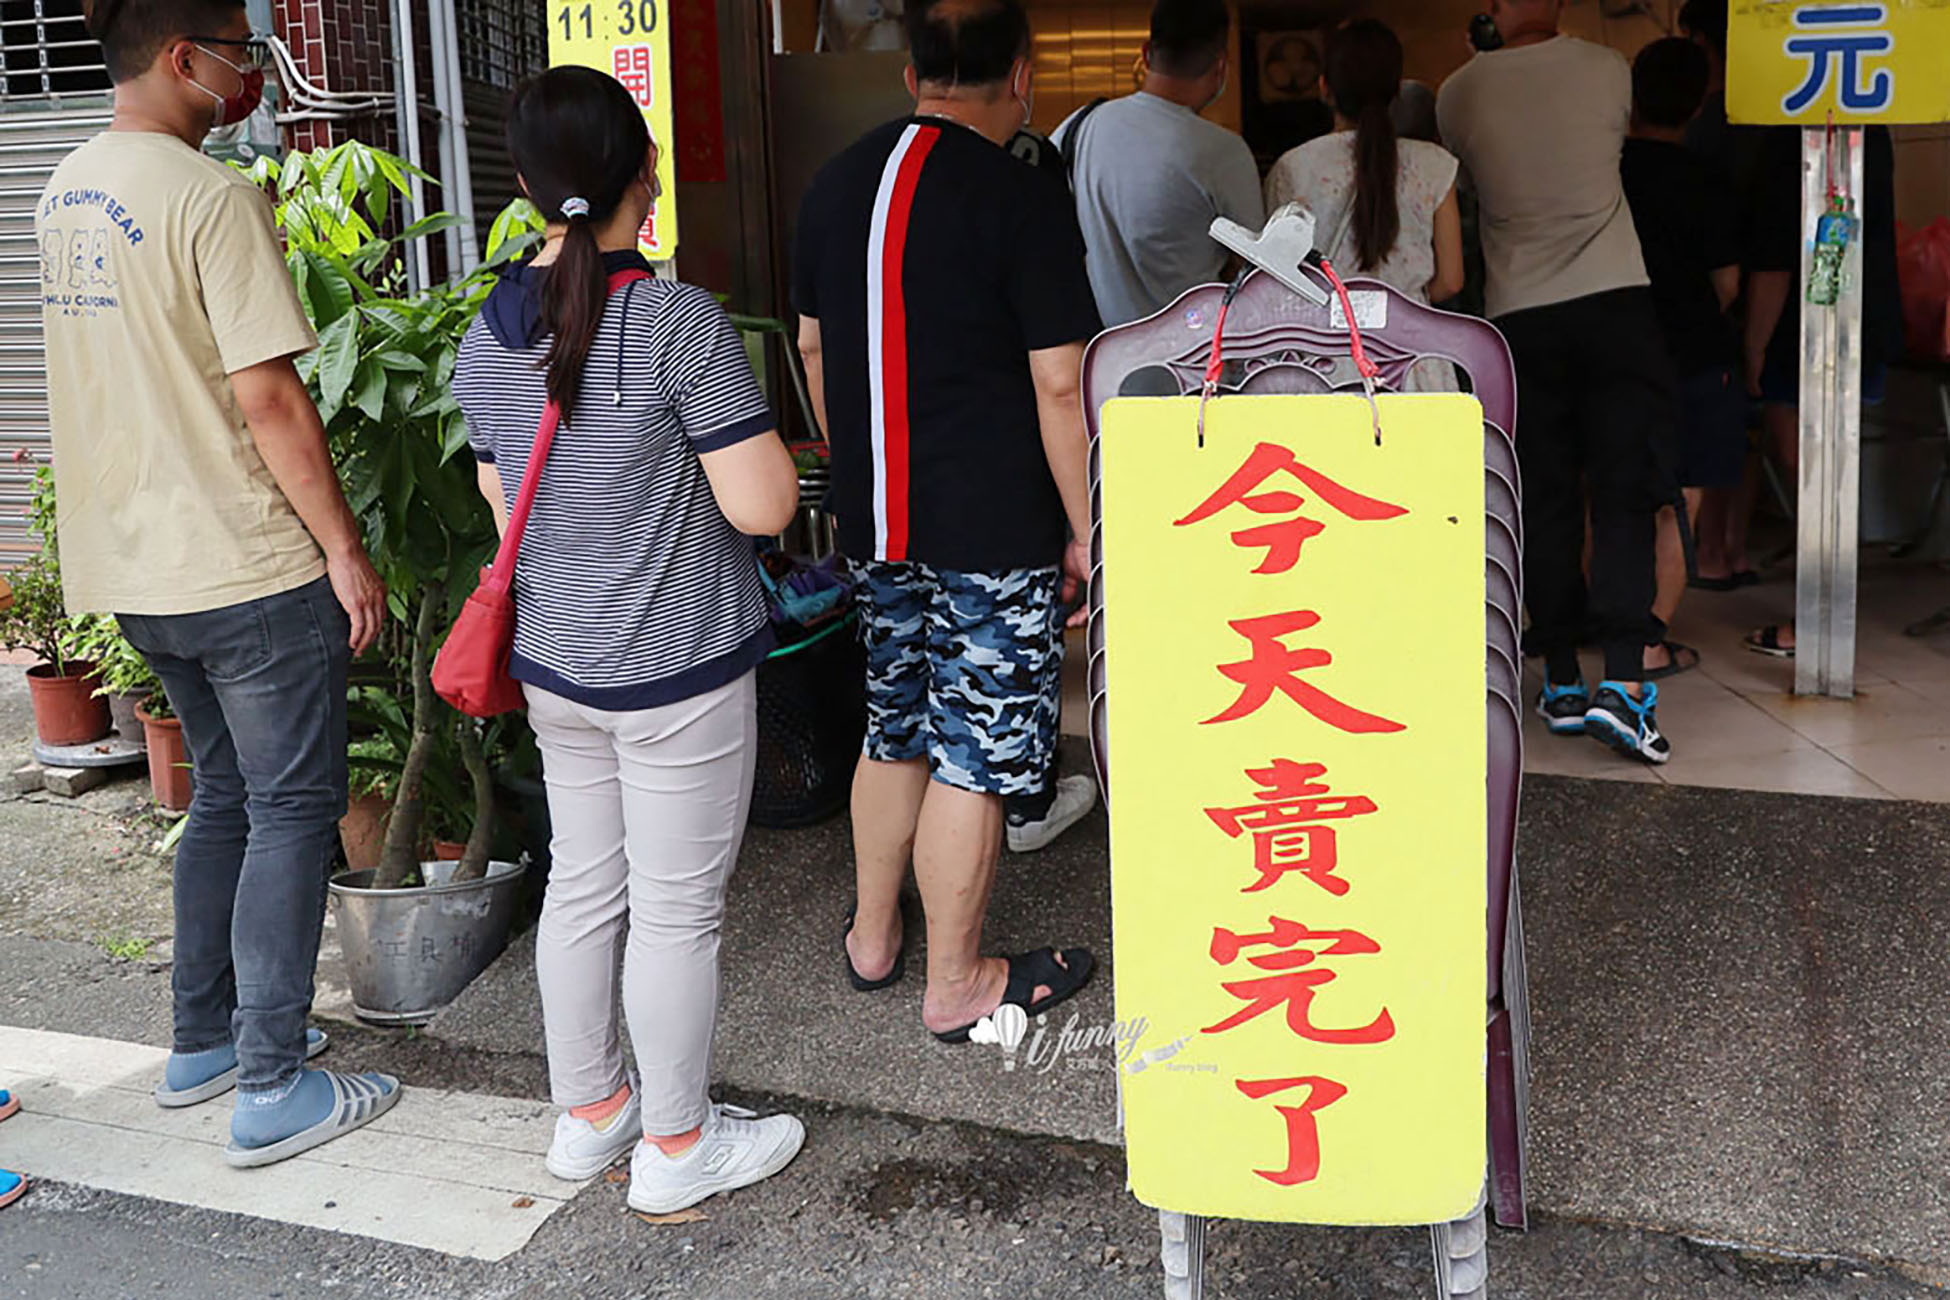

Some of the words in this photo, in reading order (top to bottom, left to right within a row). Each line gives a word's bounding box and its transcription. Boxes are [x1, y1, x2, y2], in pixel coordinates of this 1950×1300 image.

[558, 0, 657, 41] 11:30
[1783, 5, 1891, 113] 元
[1173, 441, 1408, 1186] 今天賣完了
